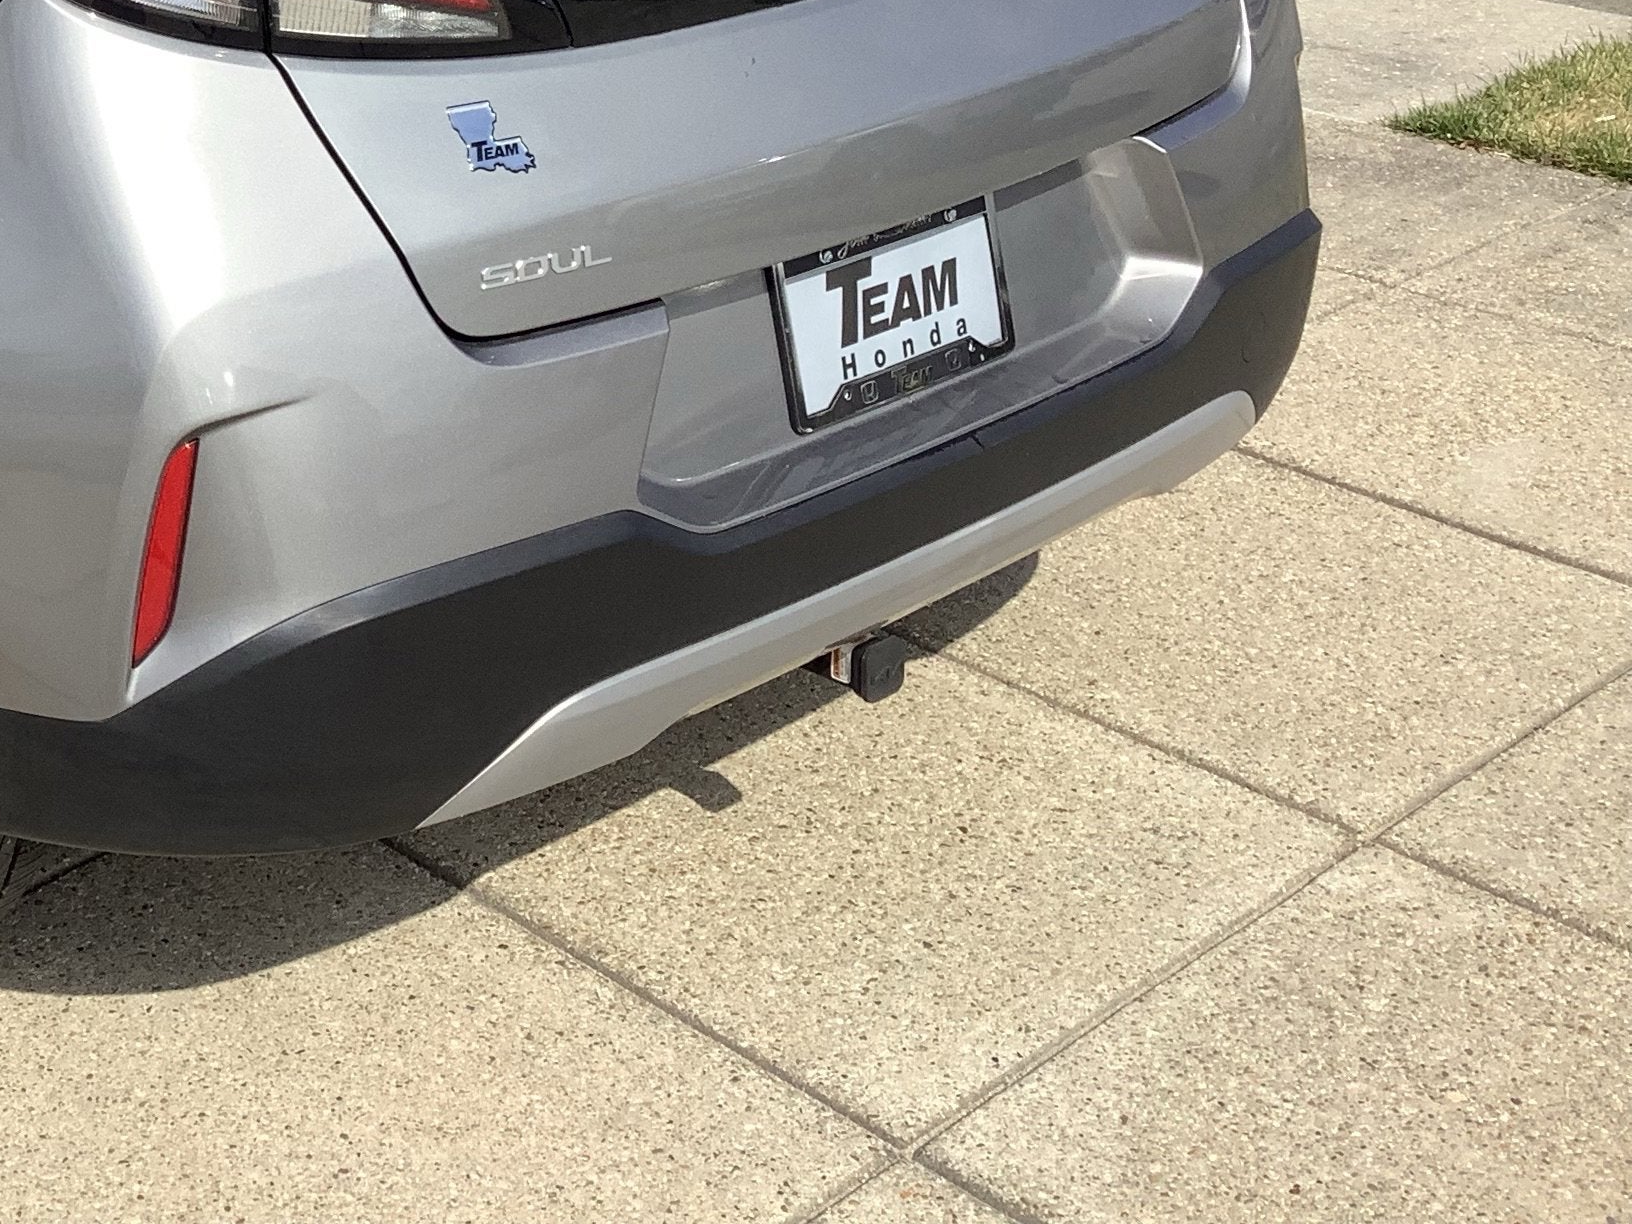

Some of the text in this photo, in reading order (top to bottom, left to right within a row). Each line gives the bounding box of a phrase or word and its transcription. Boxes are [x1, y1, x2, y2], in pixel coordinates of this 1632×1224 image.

[471, 140, 519, 162] TEAM
[480, 245, 613, 290] SOUL
[825, 256, 959, 349] TEAM
[841, 317, 968, 380] Honda
